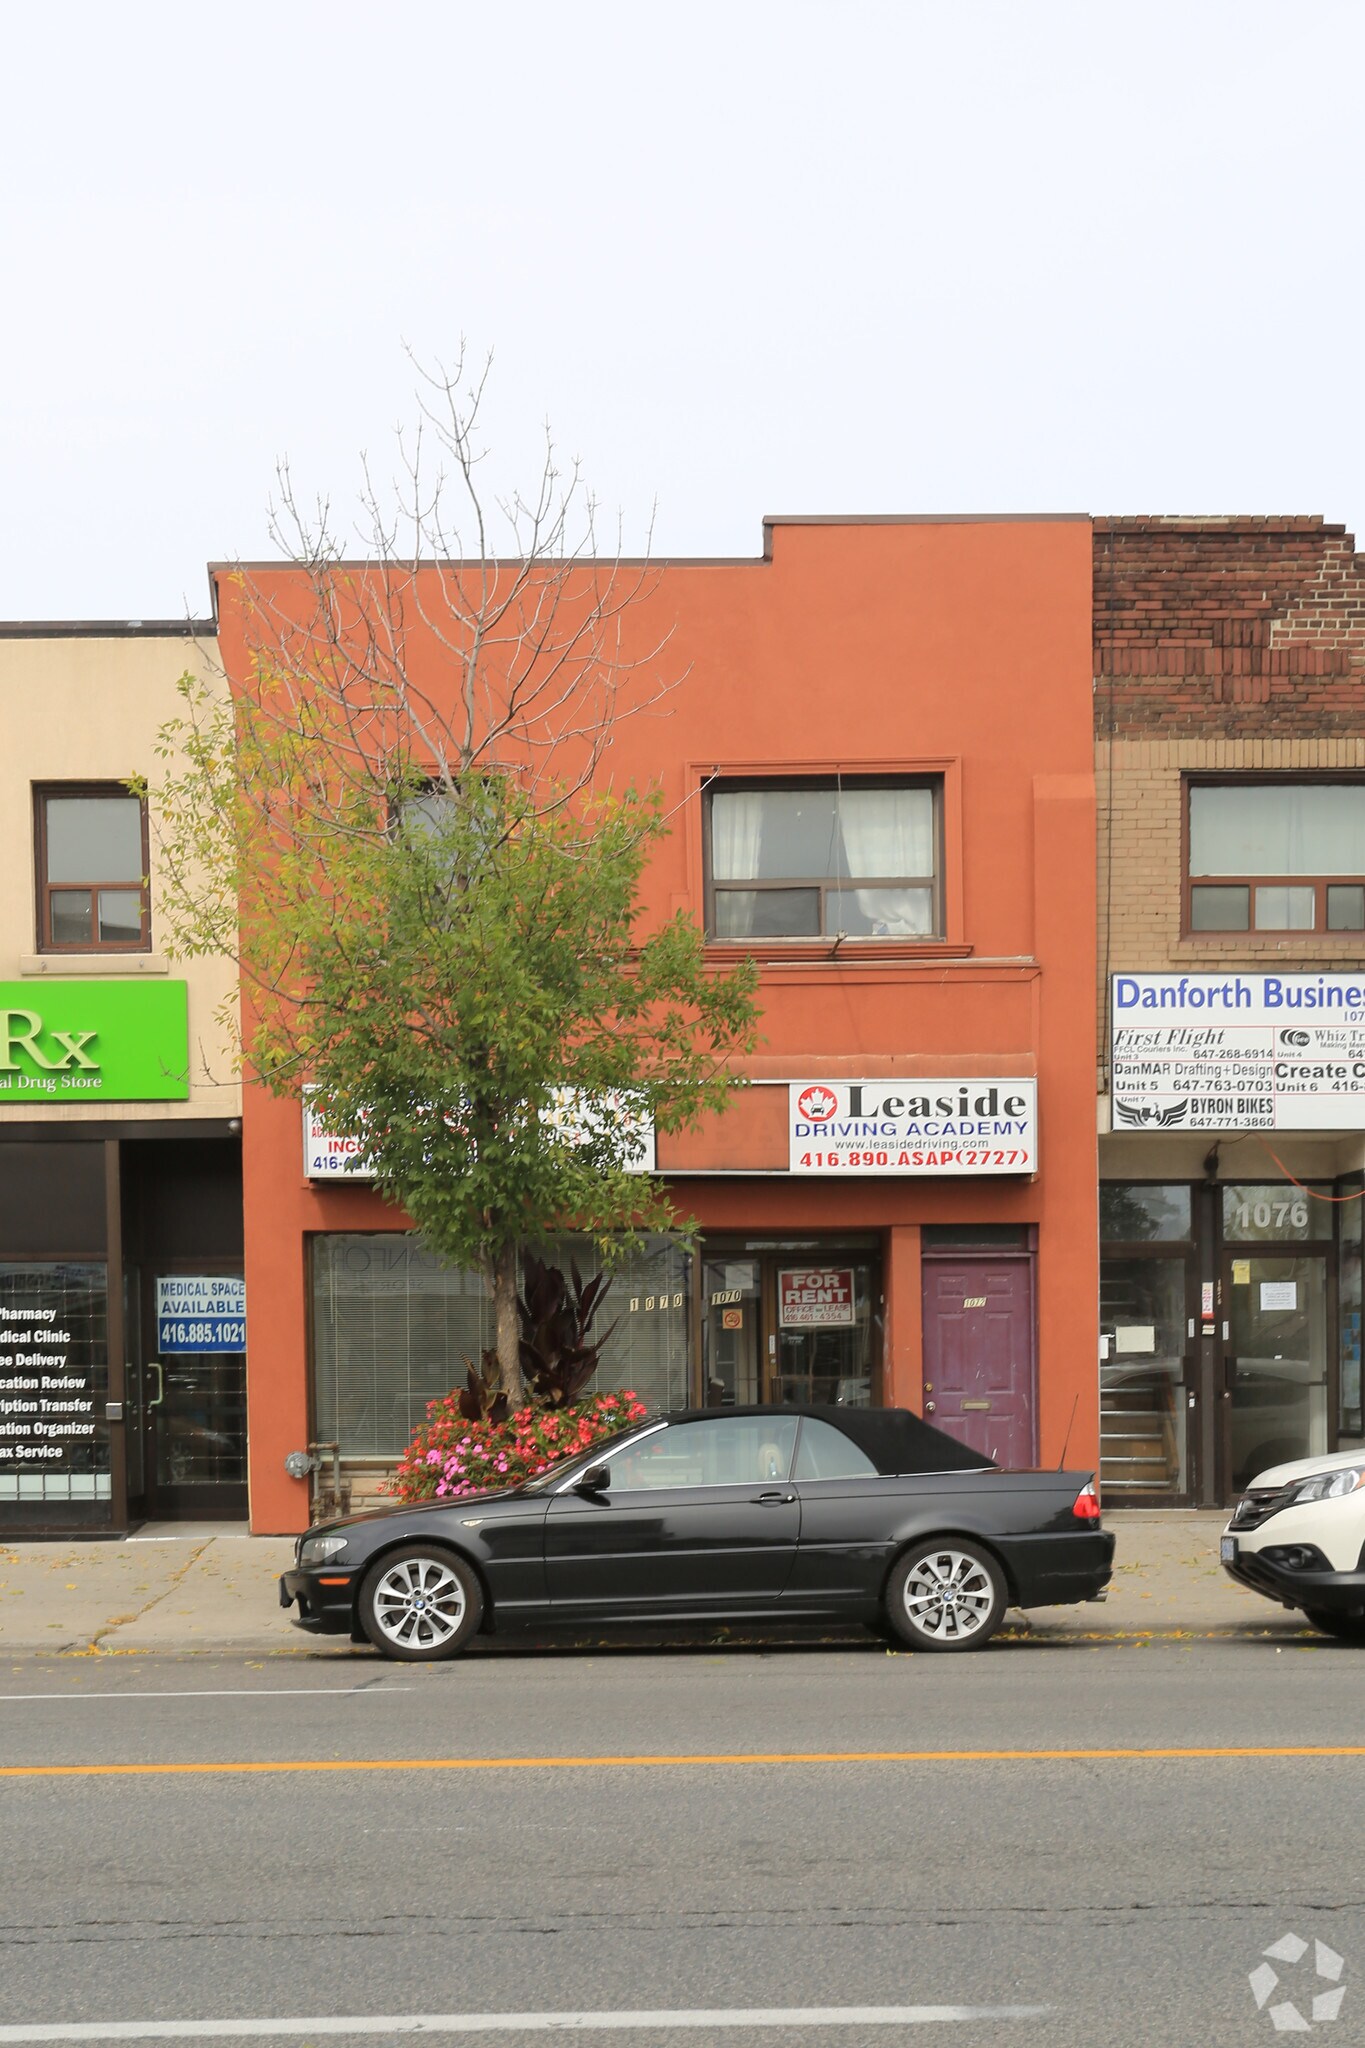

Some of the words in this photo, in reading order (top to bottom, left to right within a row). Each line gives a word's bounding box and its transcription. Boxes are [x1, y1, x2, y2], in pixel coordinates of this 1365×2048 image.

[1116, 978, 1251, 1008] Danforth
[0, 1009, 100, 1070] Rx
[1114, 1029, 1162, 1045] First
[1166, 1029, 1226, 1048] Flight
[1315, 1030, 1346, 1041] Whiz
[1194, 1049, 1273, 1059] 647-268-6914
[1348, 1050, 1365, 1058] 64
[1114, 1063, 1171, 1075] DanMAR
[1275, 1062, 1347, 1079] Create
[17, 1075, 57, 1093] Drug
[61, 1074, 102, 1089] Store
[1116, 1081, 1147, 1091] Unit
[1150, 1081, 1159, 1091] 5
[1173, 1080, 1273, 1091] 647-763-0703
[1276, 1082, 1308, 1092] Unit
[1310, 1082, 1318, 1092] 6
[1332, 1081, 1365, 1091] 416-
[844, 1085, 1027, 1119] Leaside
[1191, 1098, 1233, 1114] BYRON
[1237, 1098, 1273, 1114] BIKES
[1190, 1117, 1274, 1127] 647-771-3860
[795, 1122, 897, 1138] DRIVING
[906, 1121, 1029, 1136] ACADEMY
[834, 1138, 989, 1151] www.leasidedriving.com
[800, 1149, 1029, 1167] 416.890.ASAP(2727)
[1236, 1202, 1309, 1228] 1076
[792, 1274, 840, 1289] FOR
[161, 1282, 208, 1296] MEDICAL
[211, 1282, 245, 1296] SPACE
[785, 1288, 848, 1304] RENT
[713, 1290, 741, 1304] 1070
[162, 1300, 245, 1314] AVAILABLE
[33, 1329, 71, 1343] Clinic
[162, 1322, 246, 1343] 416.885.1021
[15, 1353, 67, 1368] Delivery
[41, 1376, 86, 1389] Review
[40, 1398, 93, 1412] Transfer
[33, 1421, 96, 1437] Organizer
[15, 1444, 63, 1458] Service
